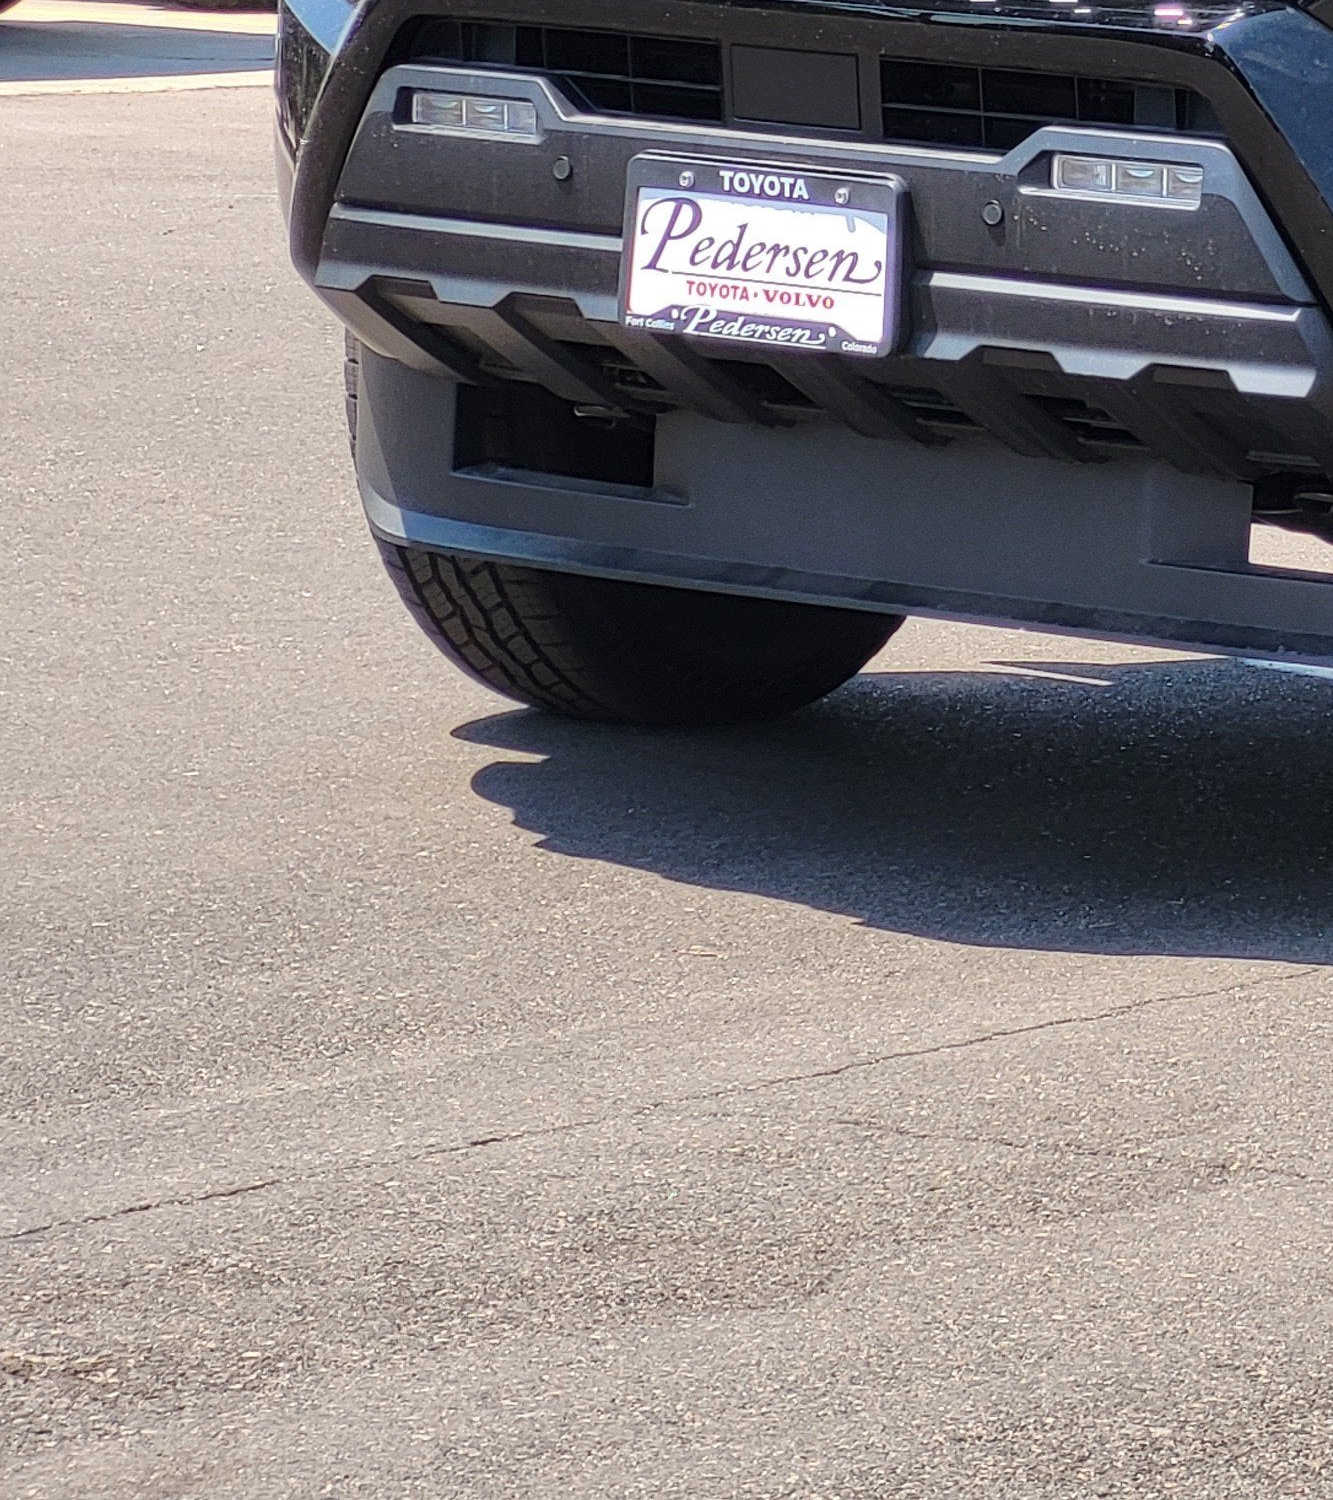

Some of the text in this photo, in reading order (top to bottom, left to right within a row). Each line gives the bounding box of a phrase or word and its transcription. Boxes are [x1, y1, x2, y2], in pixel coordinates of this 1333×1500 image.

[719, 170, 809, 200] TOYOTA
[640, 197, 882, 284] Pedersen
[686, 280, 835, 310] TOYOTA VOLVO
[680, 304, 827, 345] Pedersen
